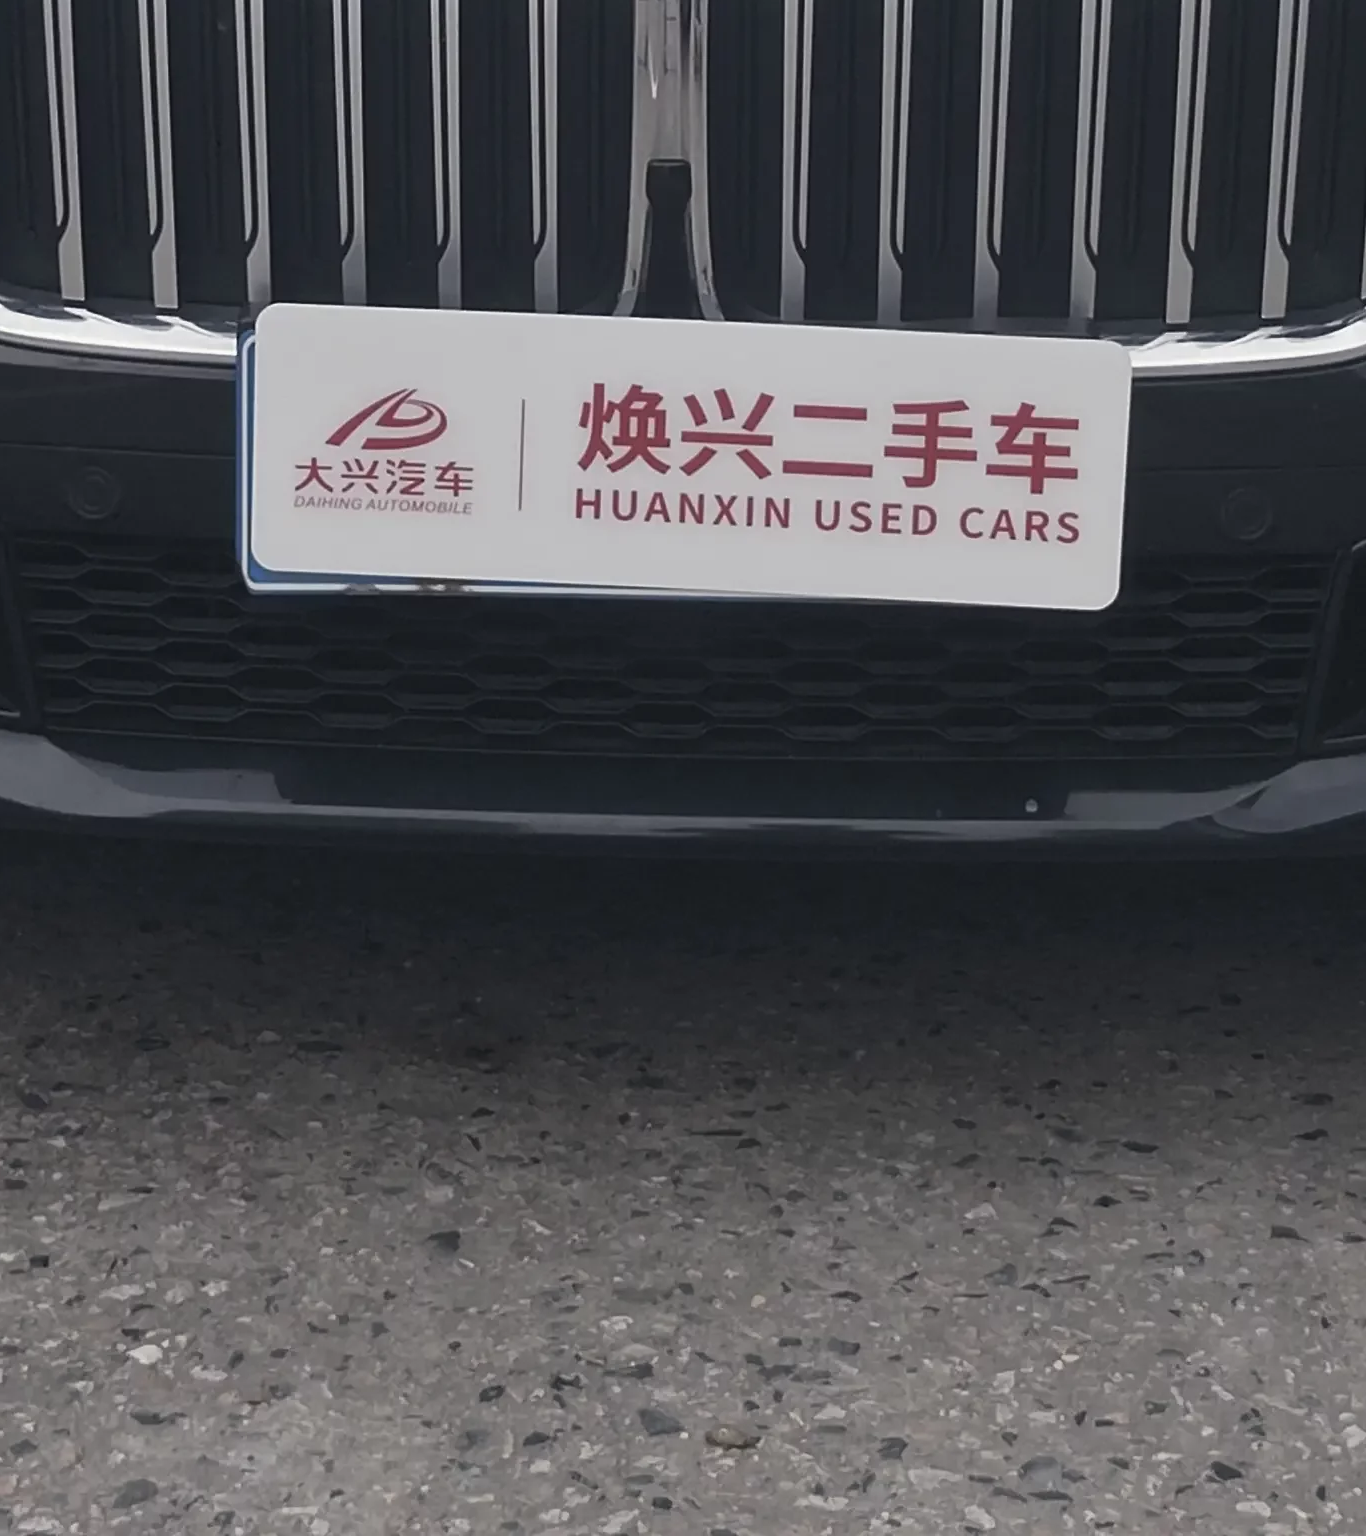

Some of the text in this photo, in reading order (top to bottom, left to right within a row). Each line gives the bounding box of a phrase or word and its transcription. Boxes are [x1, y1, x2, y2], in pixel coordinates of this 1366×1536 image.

[577, 382, 1080, 495] 焕兴二手车
[294, 457, 474, 497] 大兴汽车
[293, 495, 473, 515] DAIHING AUTOMOBILE
[575, 487, 1080, 544] HUANXIN USED CARS
